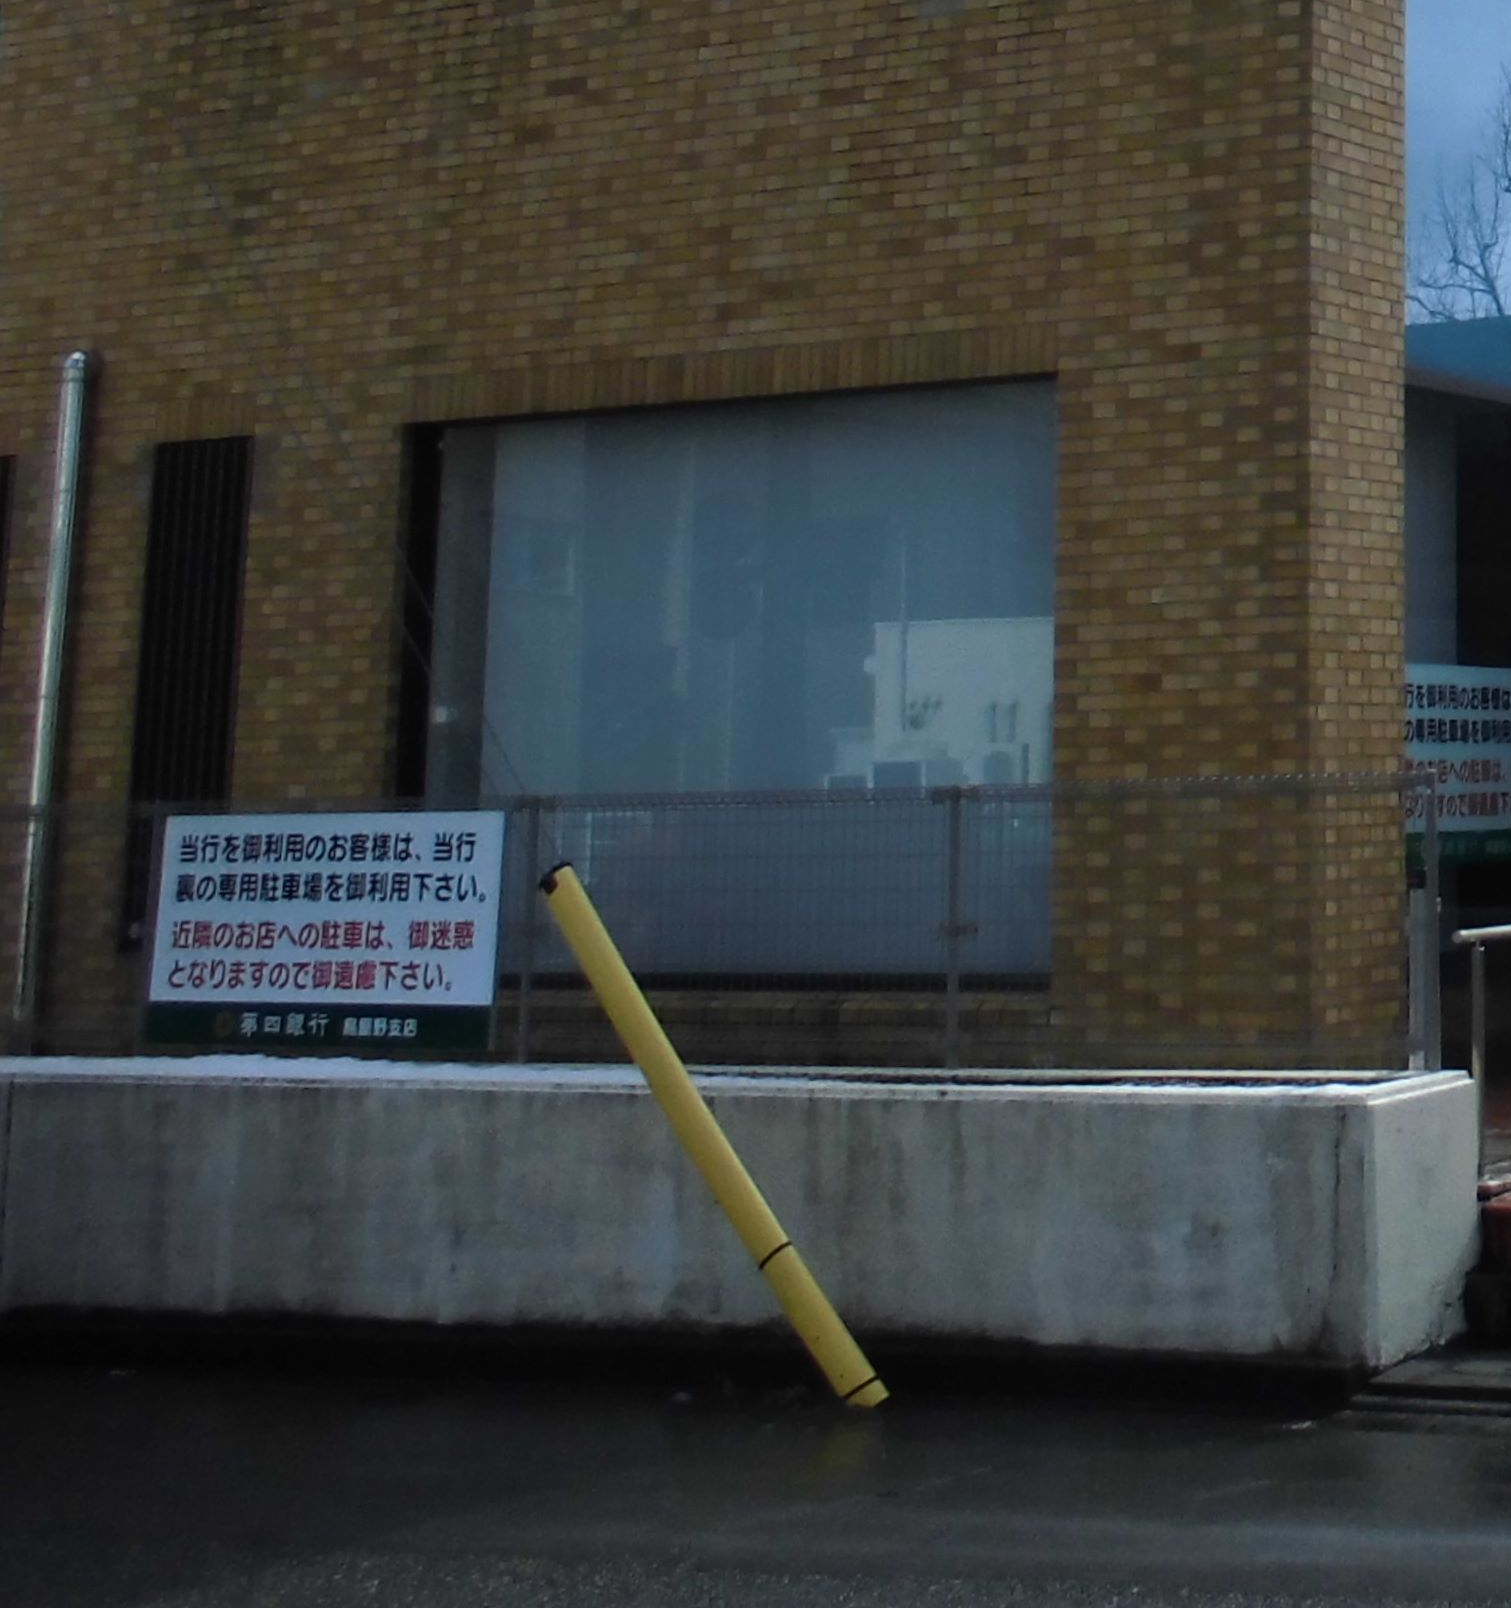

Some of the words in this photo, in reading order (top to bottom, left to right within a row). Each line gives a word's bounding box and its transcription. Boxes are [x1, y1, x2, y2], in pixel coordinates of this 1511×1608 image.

[179, 832, 477, 863] 当行を御利用のお客様は、当行
[175, 872, 487, 903] 裏の専用駐車場を御利用下さい。
[167, 960, 452, 991] となりますので御遠慮下さい。
[240, 1012, 330, 1035] 第四銀行
